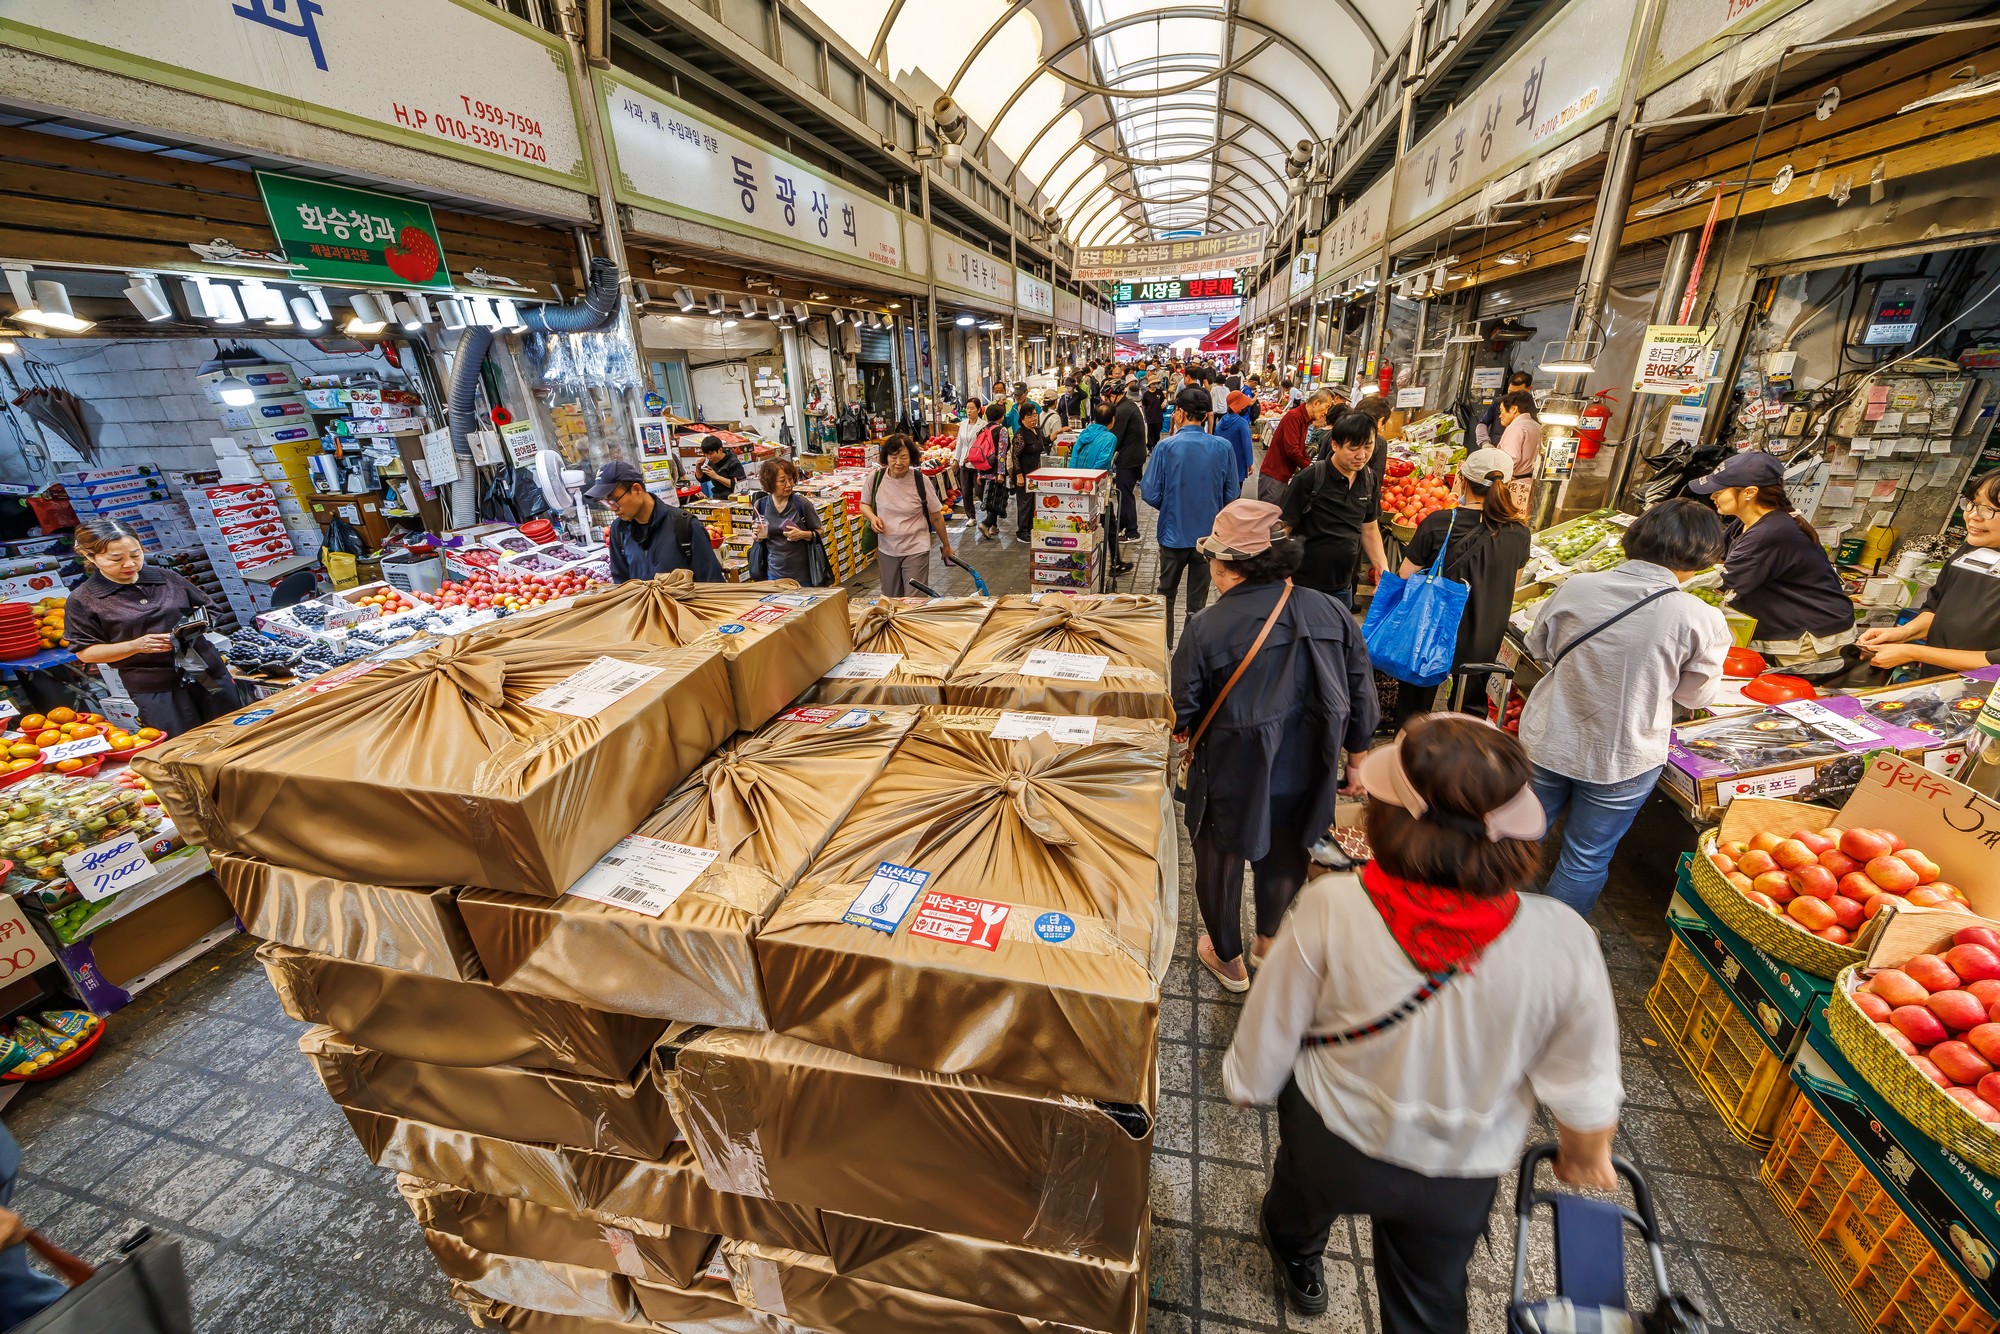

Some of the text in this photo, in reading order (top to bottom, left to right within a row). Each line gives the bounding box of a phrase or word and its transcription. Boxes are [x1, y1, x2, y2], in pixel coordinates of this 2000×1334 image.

[460, 95, 543, 138] T.959-7594
[623, 99, 719, 154] 사과, 배, 수입과일 전문
[1423, 56, 1547, 198] 대흥상회
[393, 102, 547, 162] H.P 010-5391-7220
[730, 155, 857, 247] 동광상회
[296, 203, 396, 244] 화승청과
[309, 244, 370, 262] 제철과일전문
[1140, 282, 1182, 300] 시장을
[1769, 778, 1797, 792] 포도
[876, 864, 928, 884] 신선식품
[926, 893, 983, 916] 파손주의
[844, 914, 873, 927] 긴급배송
[1037, 924, 1072, 934] 냉장보관
